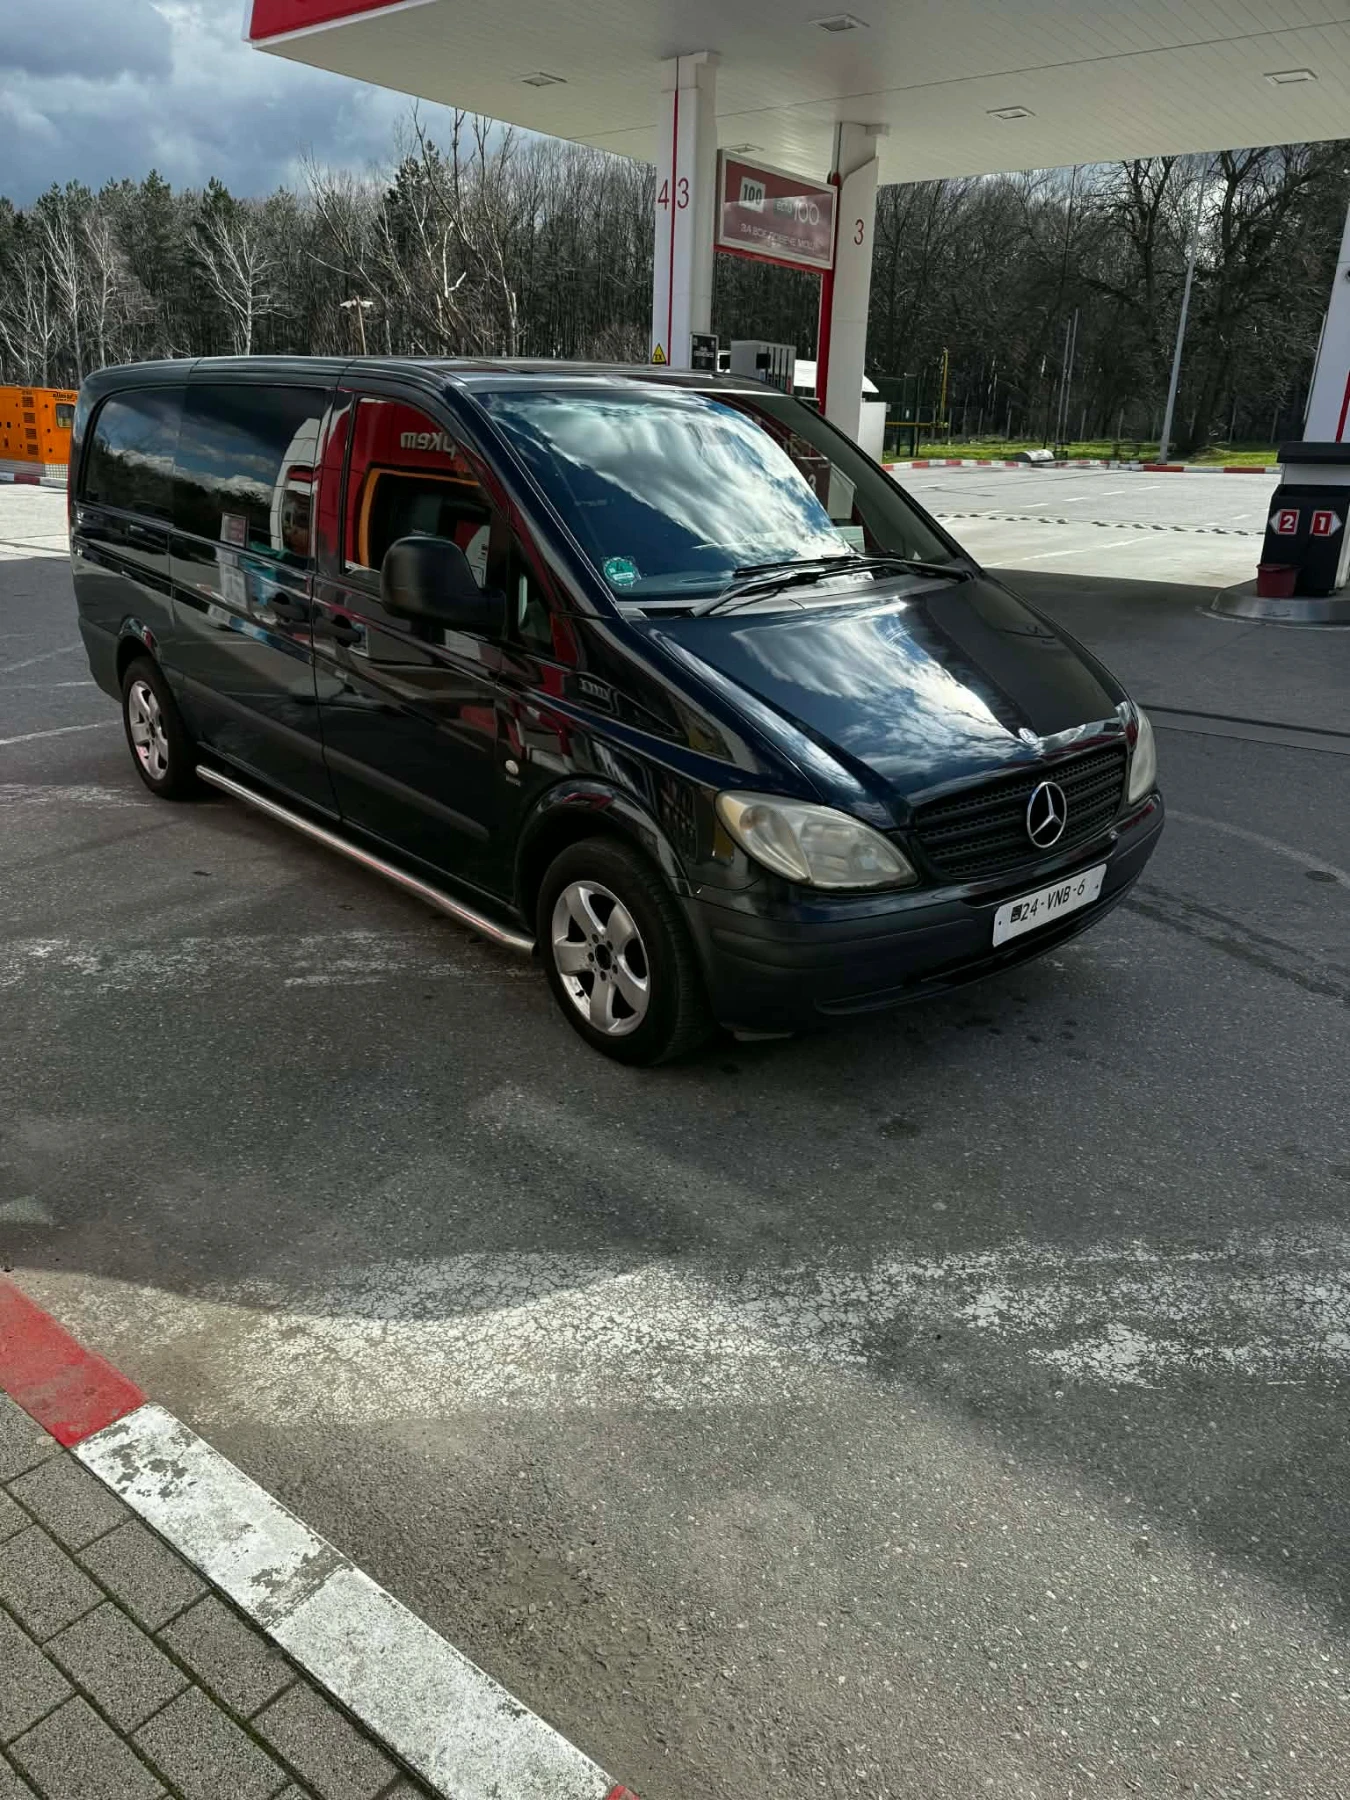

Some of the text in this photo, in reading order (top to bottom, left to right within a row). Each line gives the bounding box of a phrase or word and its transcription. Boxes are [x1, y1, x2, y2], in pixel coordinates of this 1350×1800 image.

[657, 179, 670, 210] 4
[677, 177, 689, 209] 3
[743, 184, 762, 205] 100
[794, 199, 819, 226] 100
[854, 219, 864, 245] 3
[1282, 515, 1294, 529] 2
[1319, 516, 1327, 531] 1
[1021, 878, 1086, 921] 24-VNB-6
